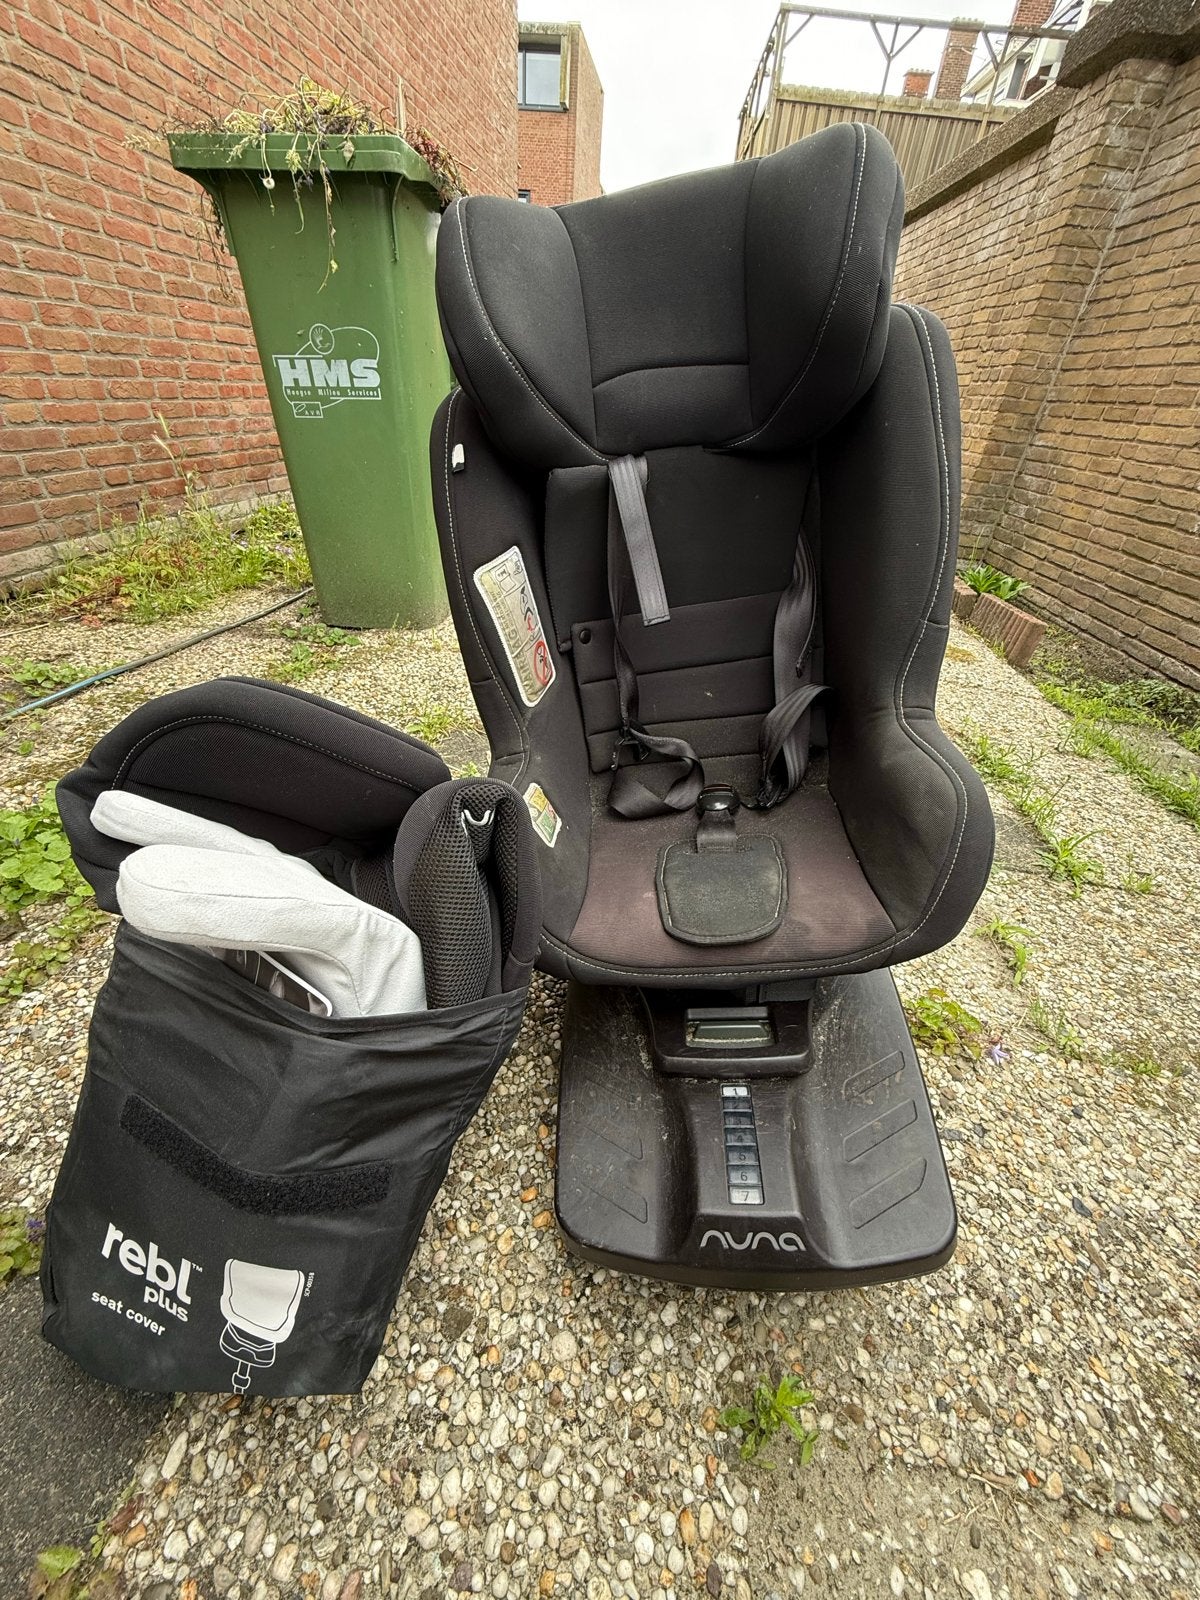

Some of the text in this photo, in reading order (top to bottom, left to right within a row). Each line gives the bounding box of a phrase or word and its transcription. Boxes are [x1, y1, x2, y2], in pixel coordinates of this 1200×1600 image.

[277, 358, 381, 388] HMS
[347, 388, 378, 397] Services
[732, 1087, 739, 1096] 1
[736, 1134, 744, 1142] 4
[738, 1151, 747, 1162] 5
[740, 1171, 748, 1182] 6
[739, 1190, 750, 1202] 7
[700, 1229, 807, 1252] nuna
[101, 1222, 192, 1305] rebl
[143, 1285, 189, 1322] plus
[91, 1291, 166, 1336] seat cover
